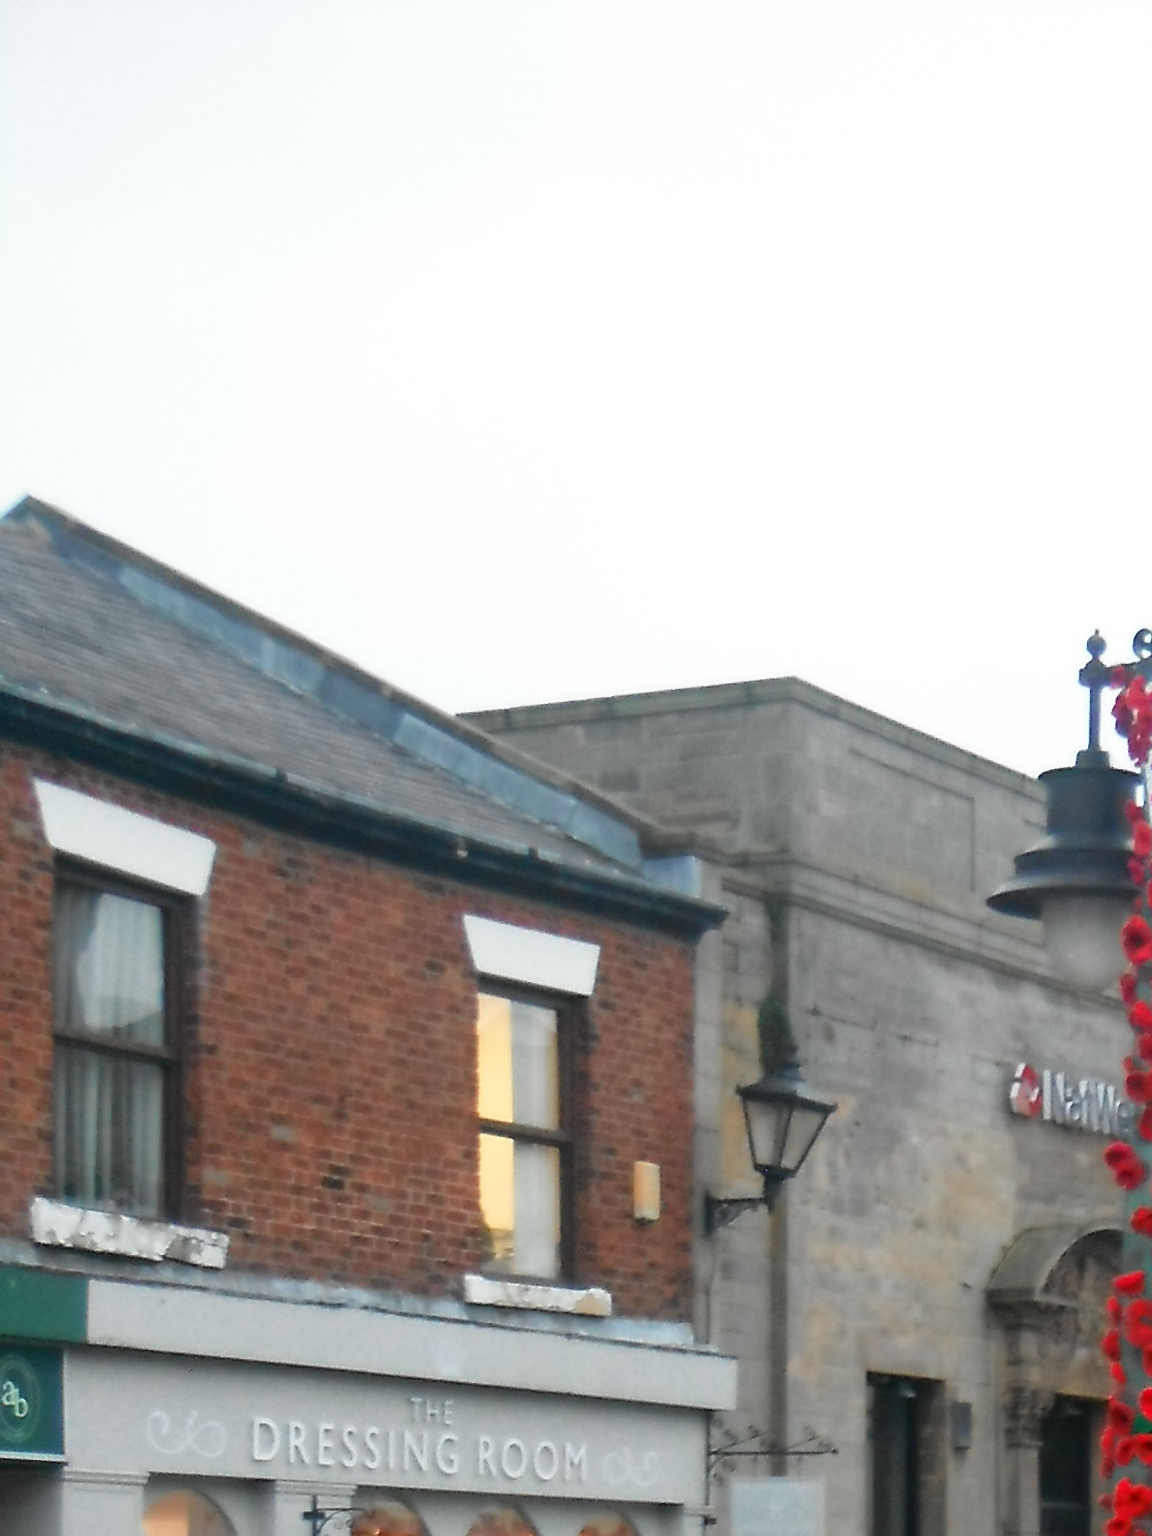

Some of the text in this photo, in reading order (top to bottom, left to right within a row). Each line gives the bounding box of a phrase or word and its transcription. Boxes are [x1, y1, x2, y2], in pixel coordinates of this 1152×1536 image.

[1042, 1069, 1131, 1138] NatWe
[409, 1397, 454, 1425] THE
[252, 1416, 587, 1482] DRESSING ROOM
